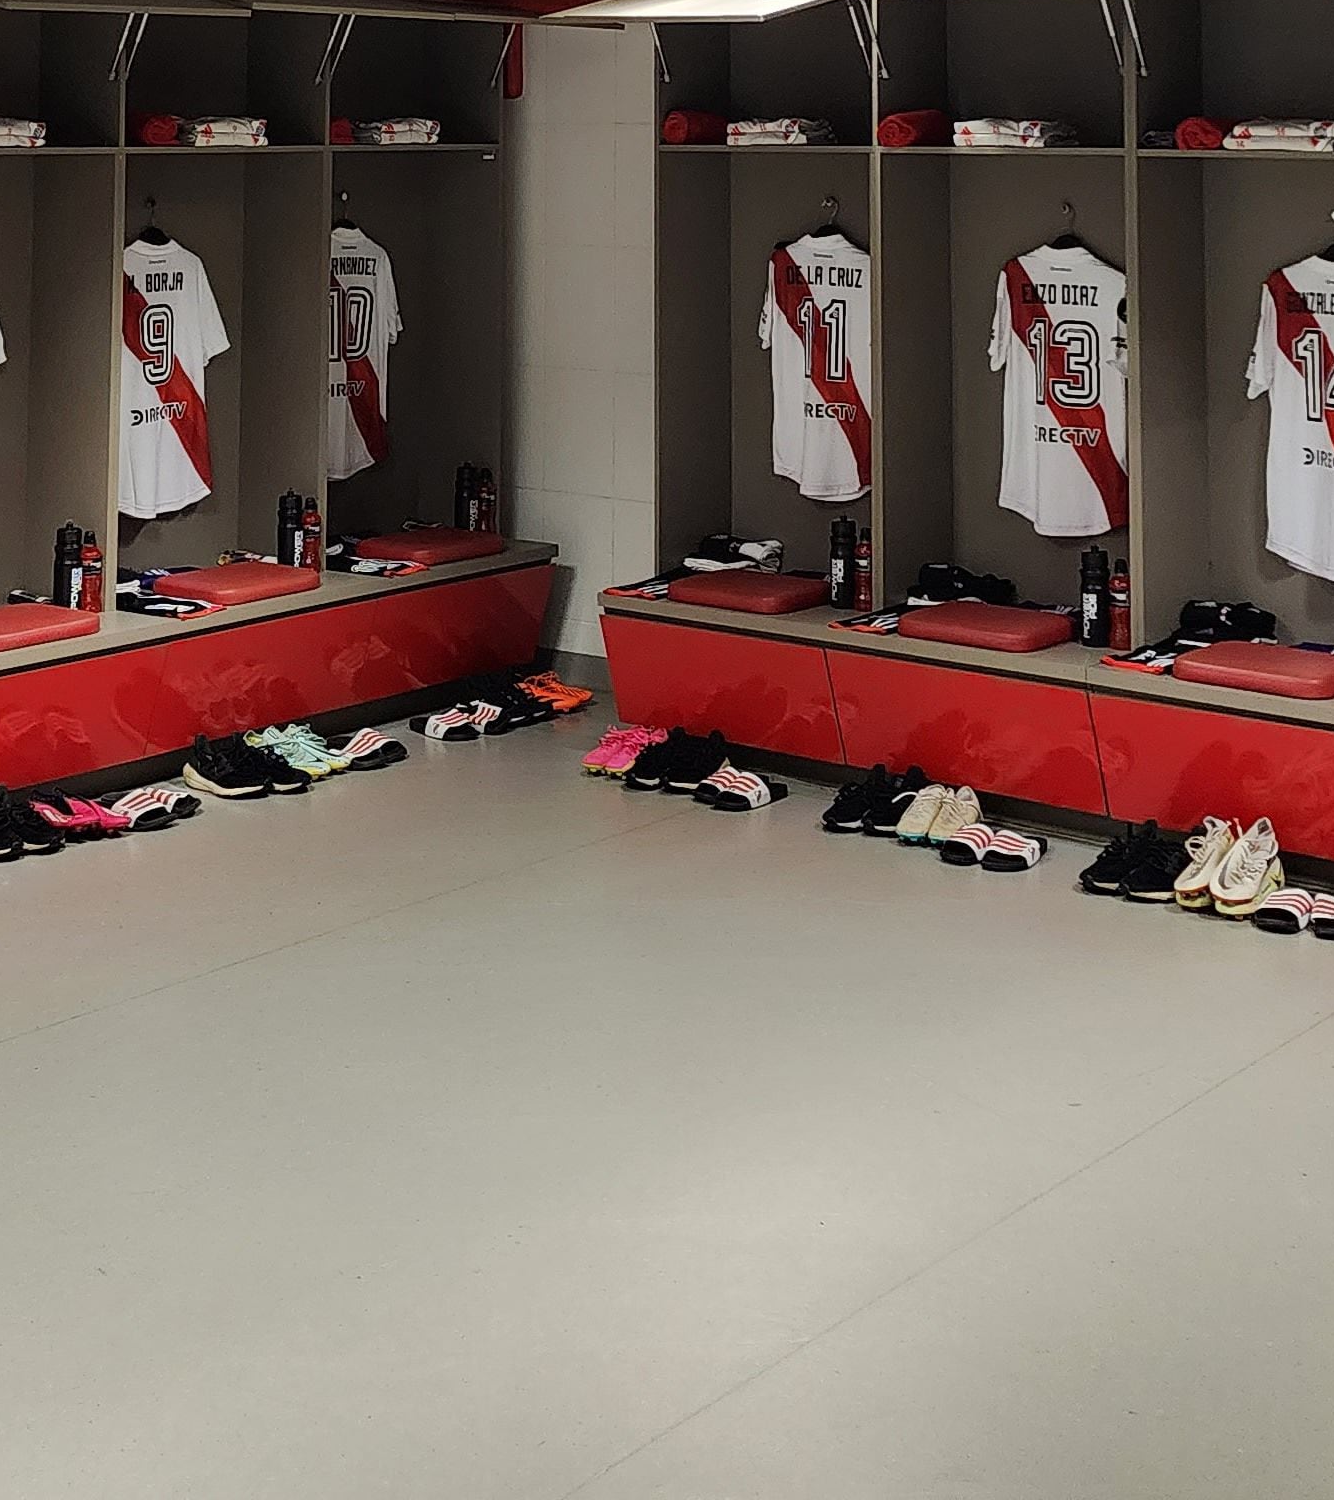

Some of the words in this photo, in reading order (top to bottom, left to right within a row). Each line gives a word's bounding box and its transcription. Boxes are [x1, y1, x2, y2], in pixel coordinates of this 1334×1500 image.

[331, 257, 377, 277] RNANDEZ
[808, 266, 822, 286] LA
[828, 268, 863, 289] CRUZ
[145, 272, 184, 293] BORJA
[1022, 283, 1057, 305] ENZO
[1061, 284, 1099, 307] DIAZ
[140, 303, 174, 386] 9
[797, 297, 847, 382] 11
[1027, 316, 1101, 408] 13
